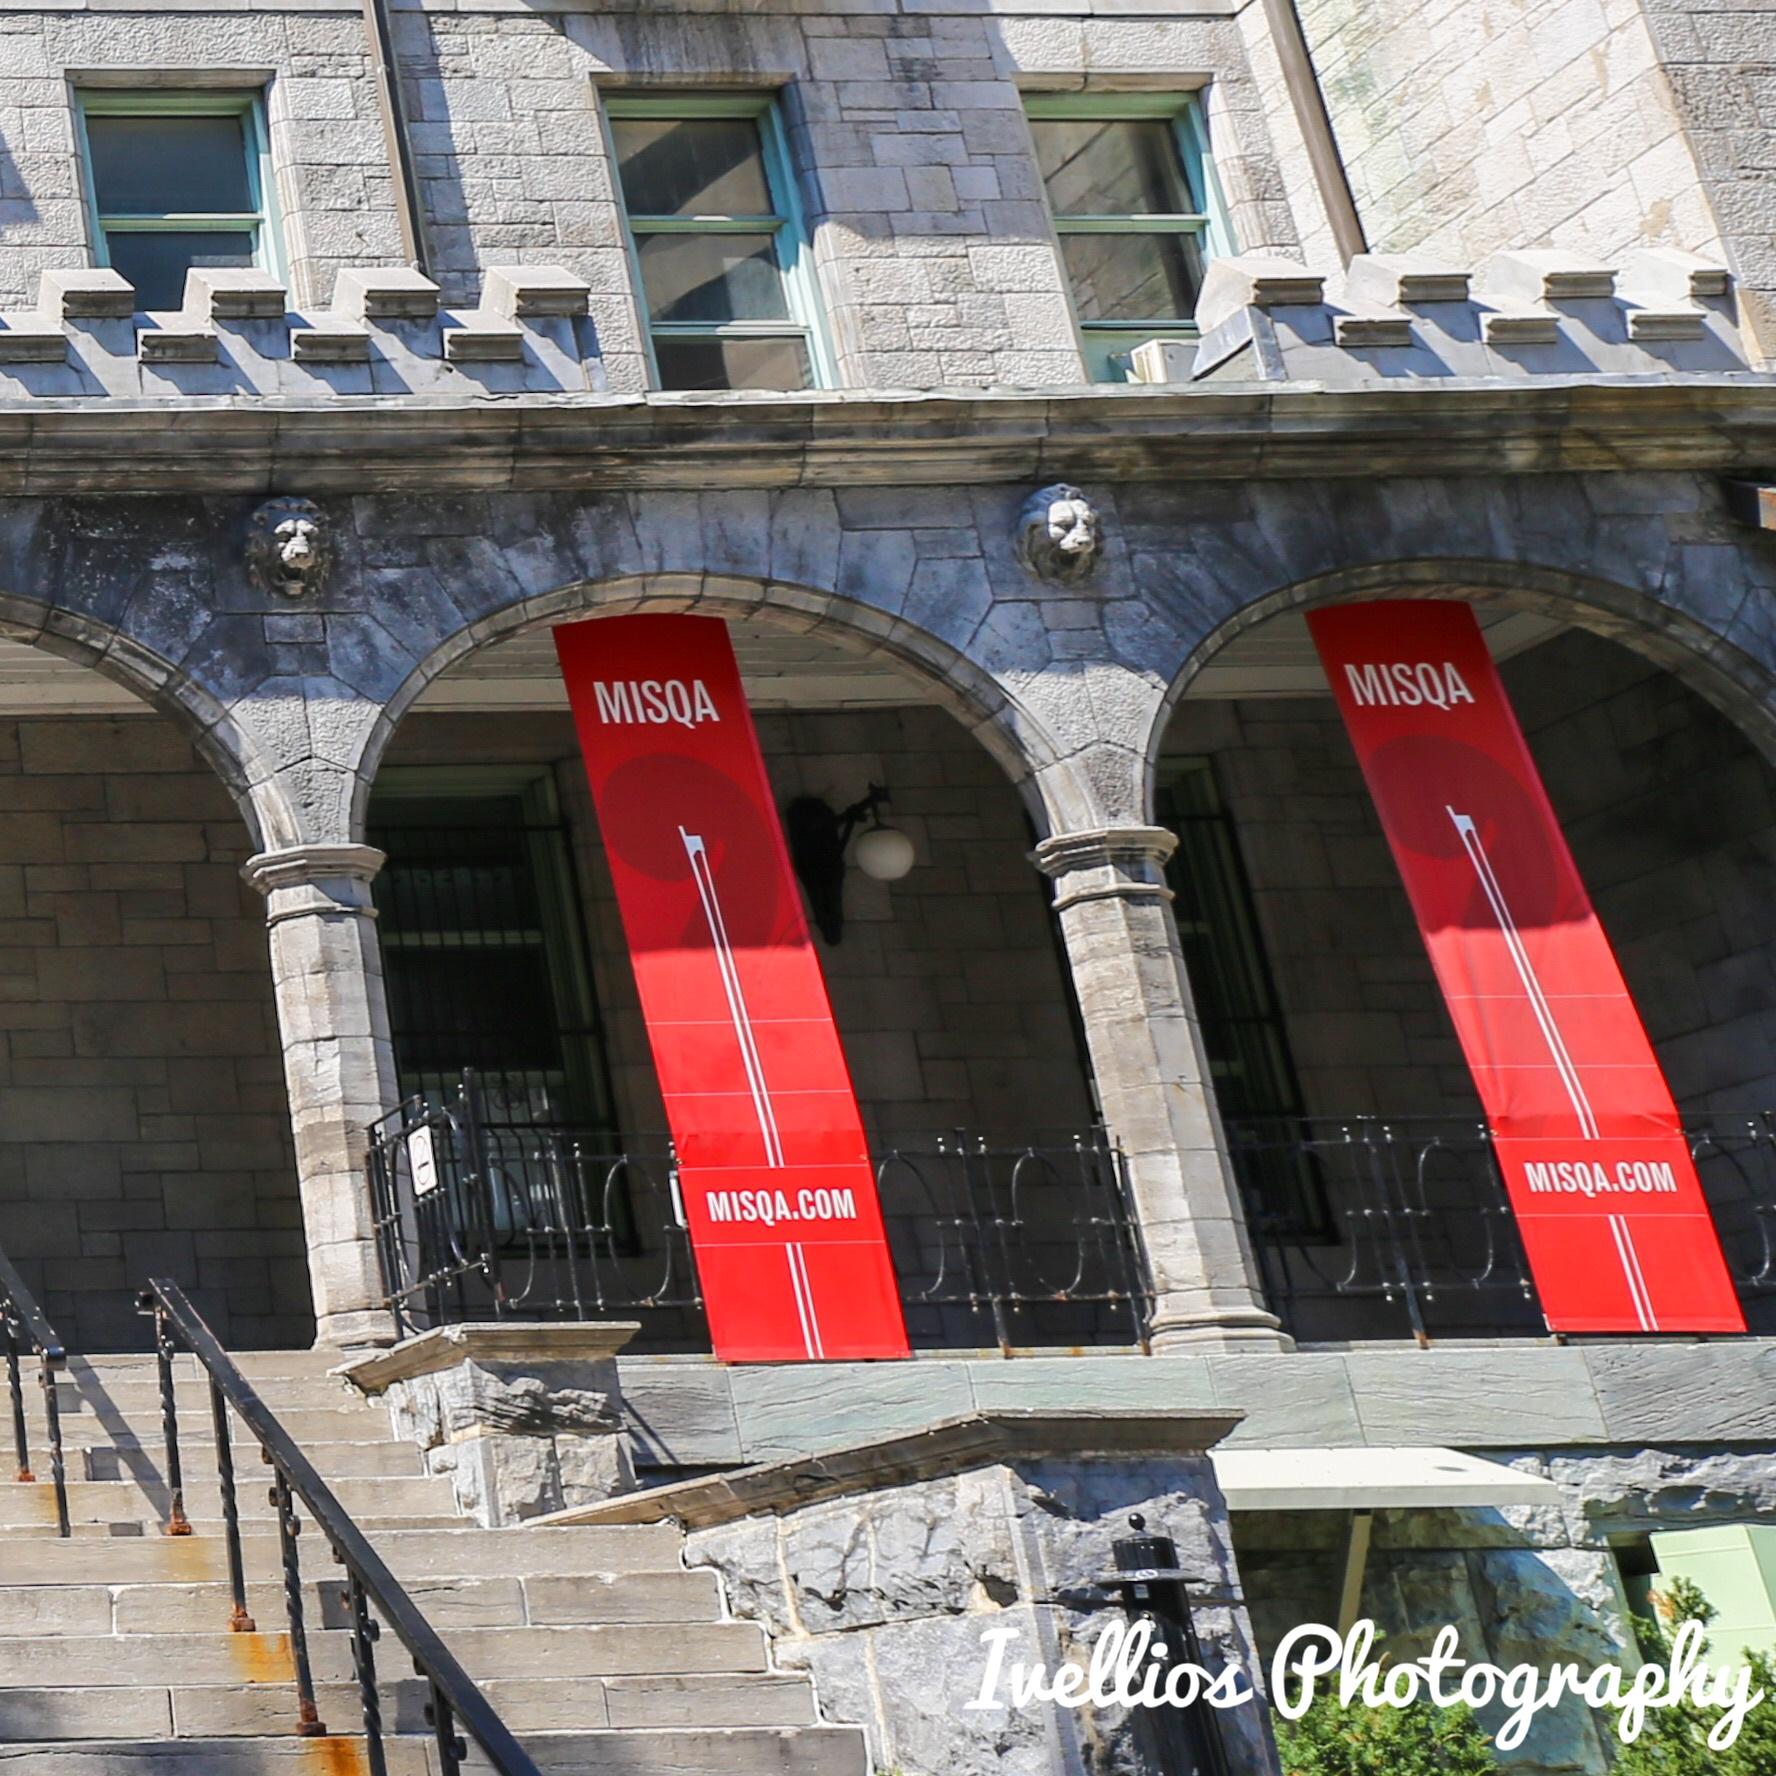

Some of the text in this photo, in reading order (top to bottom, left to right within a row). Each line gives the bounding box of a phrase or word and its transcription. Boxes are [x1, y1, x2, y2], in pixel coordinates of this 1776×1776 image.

[593, 679, 720, 729] MISQA
[1344, 661, 1476, 711] MISQA
[1523, 1161, 1678, 1198] MISQA.COM
[706, 1187, 858, 1227] MISQA.COM
